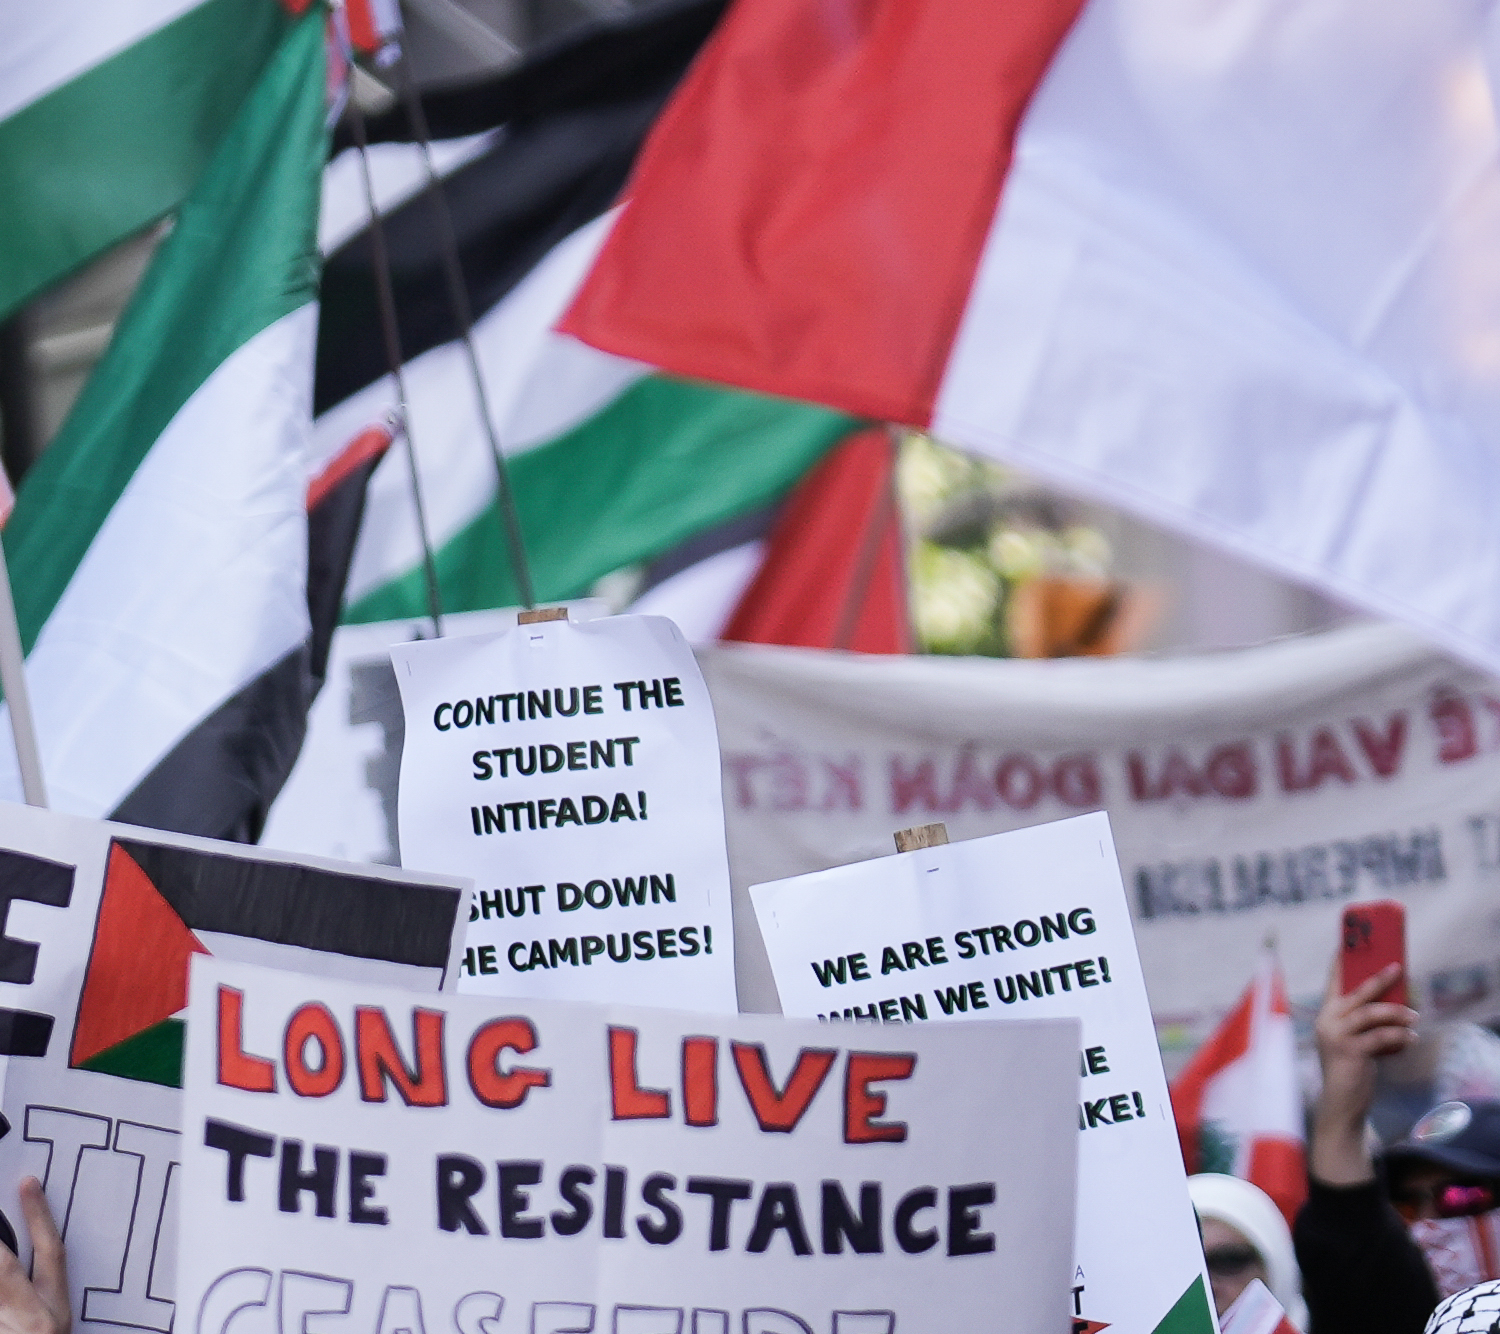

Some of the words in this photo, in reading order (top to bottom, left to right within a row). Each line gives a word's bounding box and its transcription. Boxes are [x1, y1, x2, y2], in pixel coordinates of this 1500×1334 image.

[434, 684, 604, 732] CONTINUE
[613, 677, 685, 712] THE
[472, 736, 641, 781] STUDENT
[471, 791, 648, 835] INTIFADA!
[557, 873, 678, 912] DOWN
[459, 945, 499, 978] HE
[507, 925, 714, 973] CAMPUSES!
[810, 953, 870, 988] WE
[880, 937, 949, 974] ARE
[954, 907, 1097, 958] STRONG
[933, 981, 990, 1015] WE
[994, 956, 1113, 1004] UNITE!
[215, 983, 552, 1109] LONG
[606, 1023, 919, 1145] LIVE
[203, 1118, 390, 1226] THE
[435, 1153, 997, 1257] RESISTANCE
